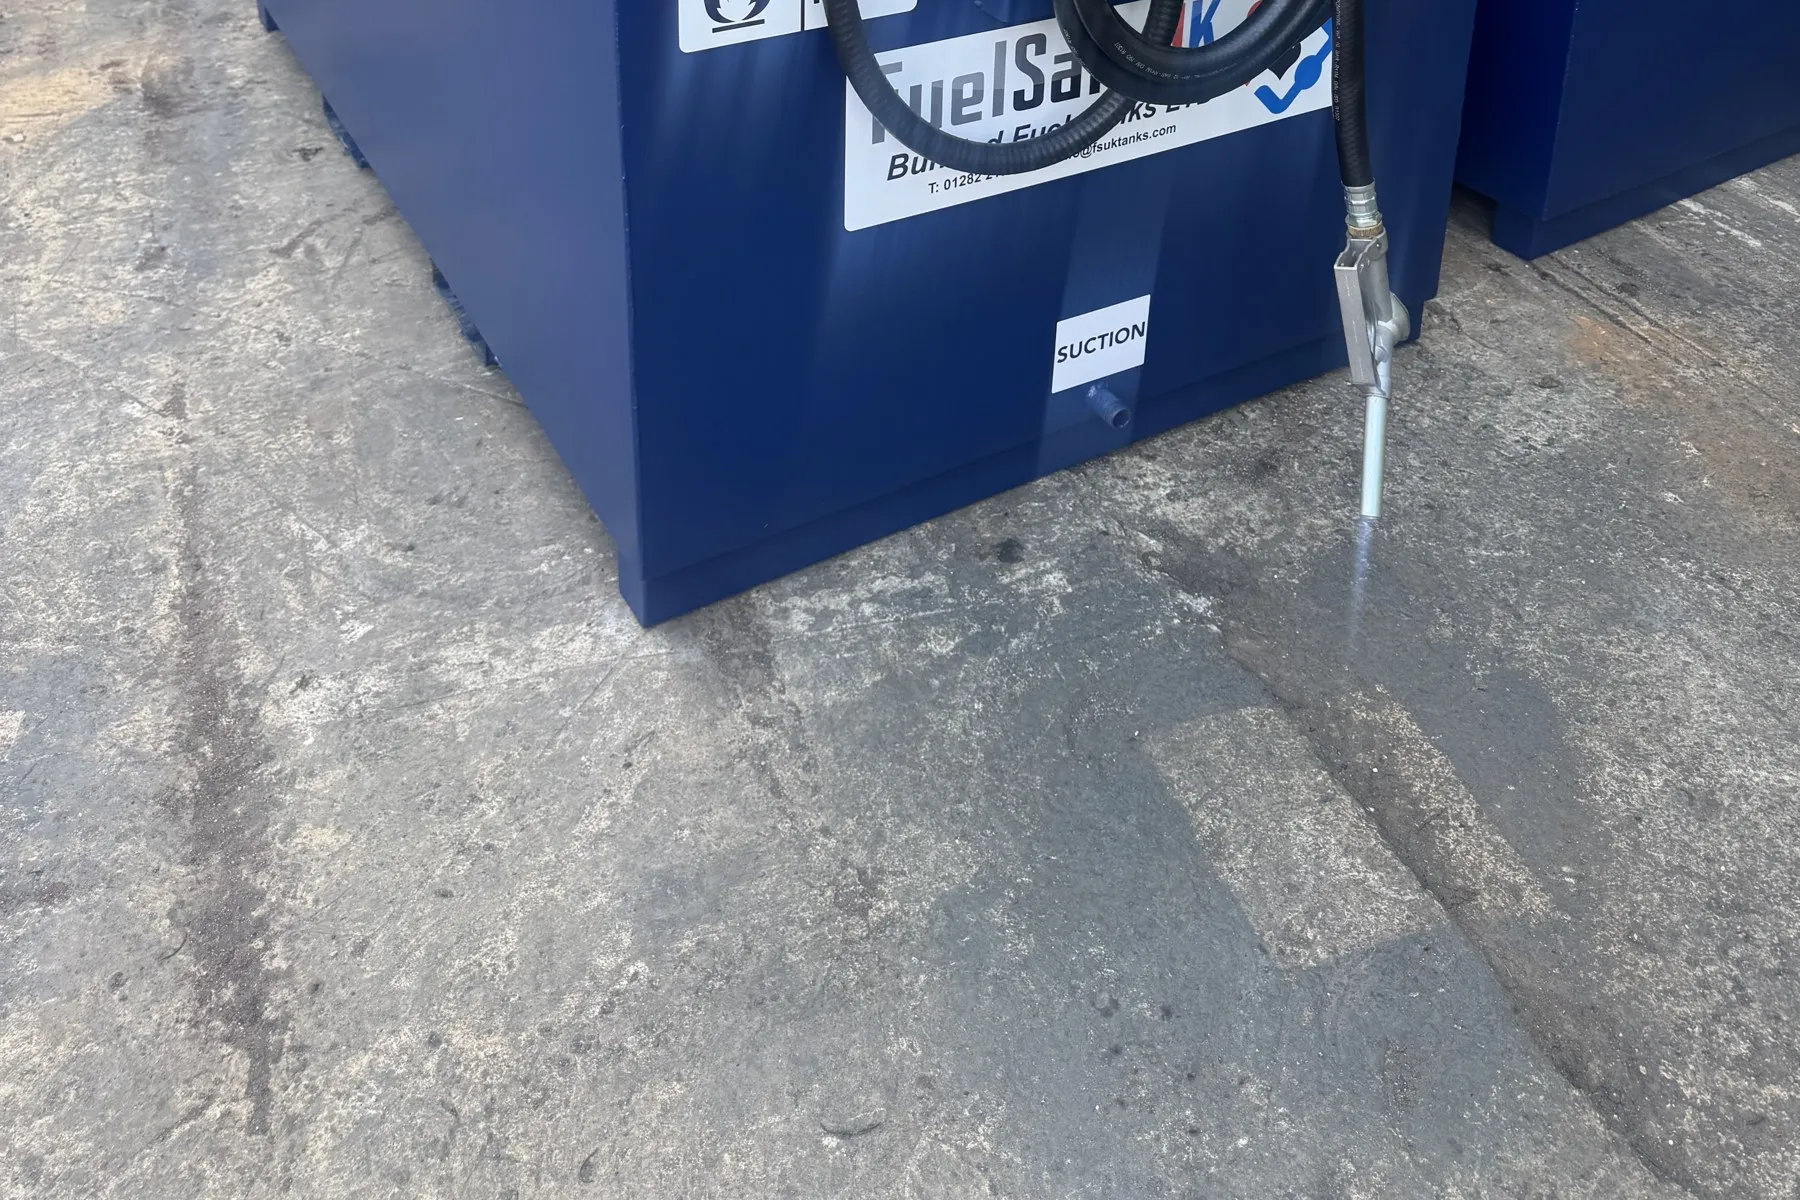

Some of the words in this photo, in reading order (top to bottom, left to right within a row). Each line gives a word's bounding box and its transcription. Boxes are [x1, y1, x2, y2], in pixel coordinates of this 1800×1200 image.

[1066, 124, 1177, 160] @fsuktanks.com
[928, 181, 939, 194] T:
[943, 171, 982, 191] 01282
[1057, 321, 1146, 364] SUCTION
